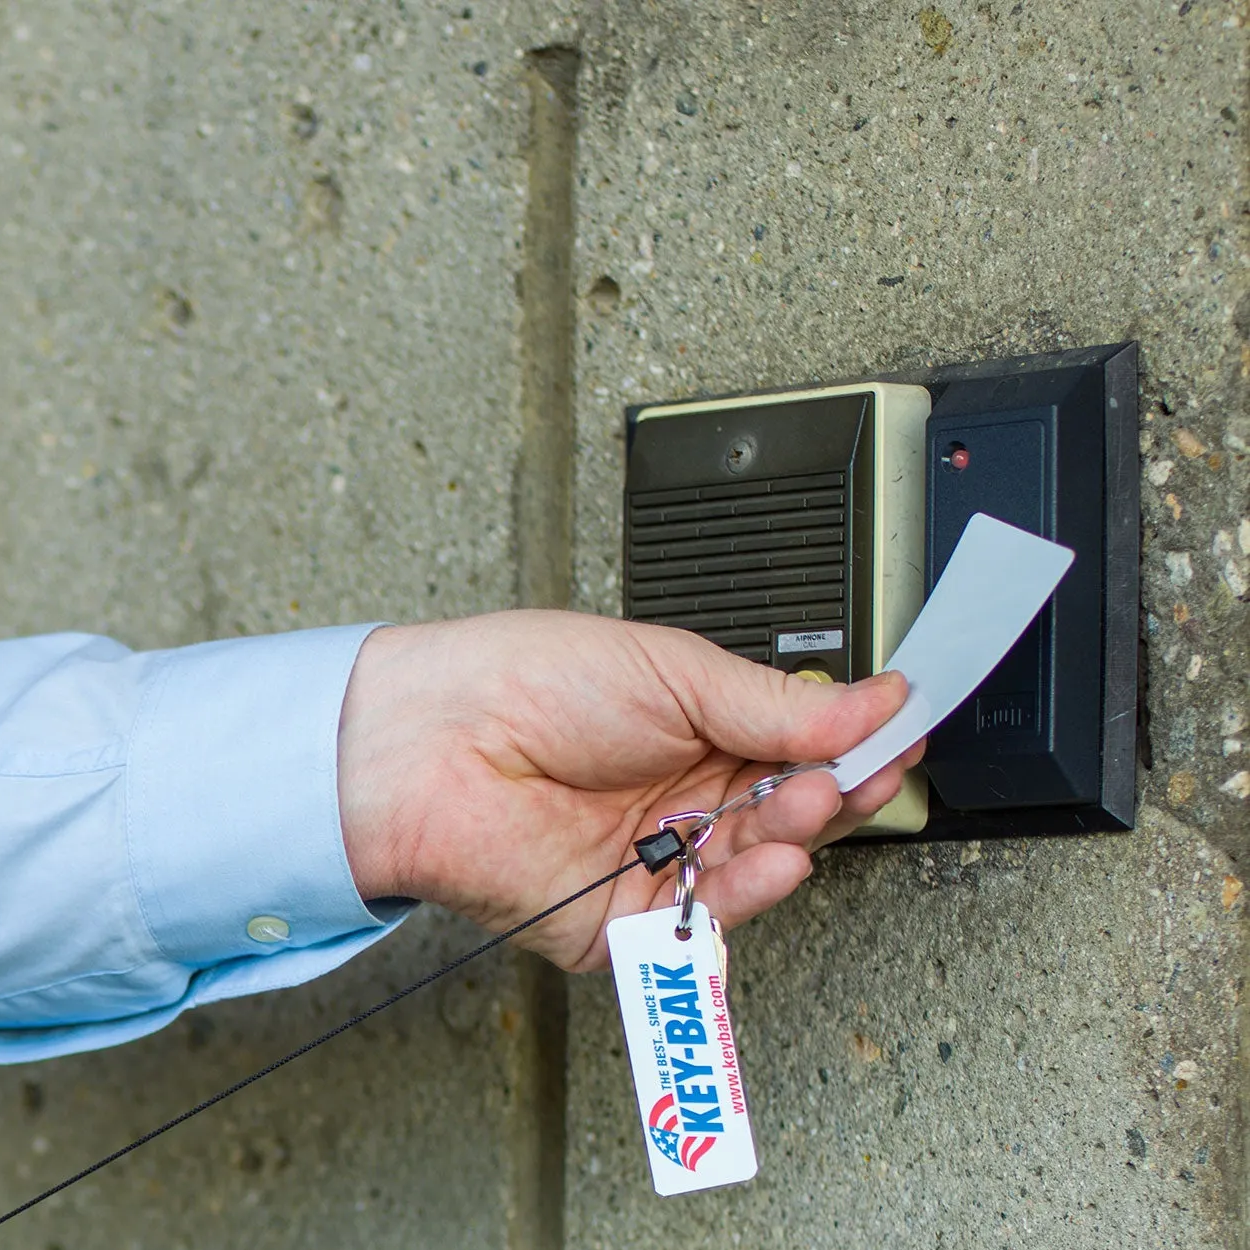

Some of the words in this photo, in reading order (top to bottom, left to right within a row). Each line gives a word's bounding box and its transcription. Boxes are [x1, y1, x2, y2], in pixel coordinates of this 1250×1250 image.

[639, 963, 653, 990] 1948
[647, 994, 661, 1027] SINCE
[652, 962, 725, 1133] KEY-BAK
[654, 1030, 669, 1067] BEST...
[708, 974, 745, 1115] www.keybak.com
[661, 1070, 672, 1091] THE
